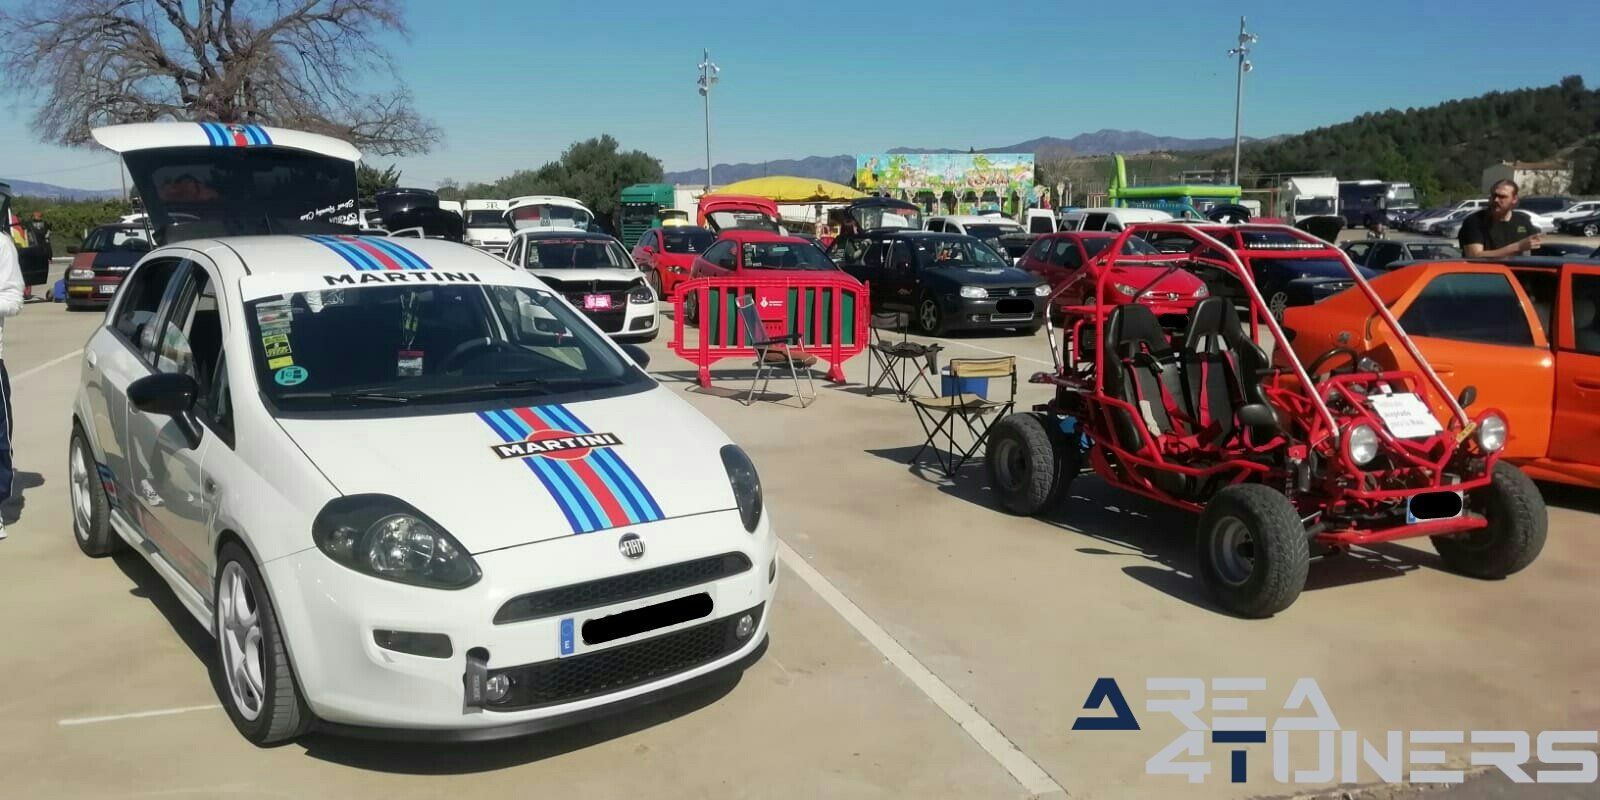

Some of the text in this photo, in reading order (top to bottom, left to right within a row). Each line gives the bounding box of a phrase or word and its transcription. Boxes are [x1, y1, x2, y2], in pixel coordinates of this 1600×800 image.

[322, 271, 482, 286] MARTINI
[499, 434, 617, 458] MARTINI
[624, 539, 645, 555] FIAT
[564, 640, 571, 650] E
